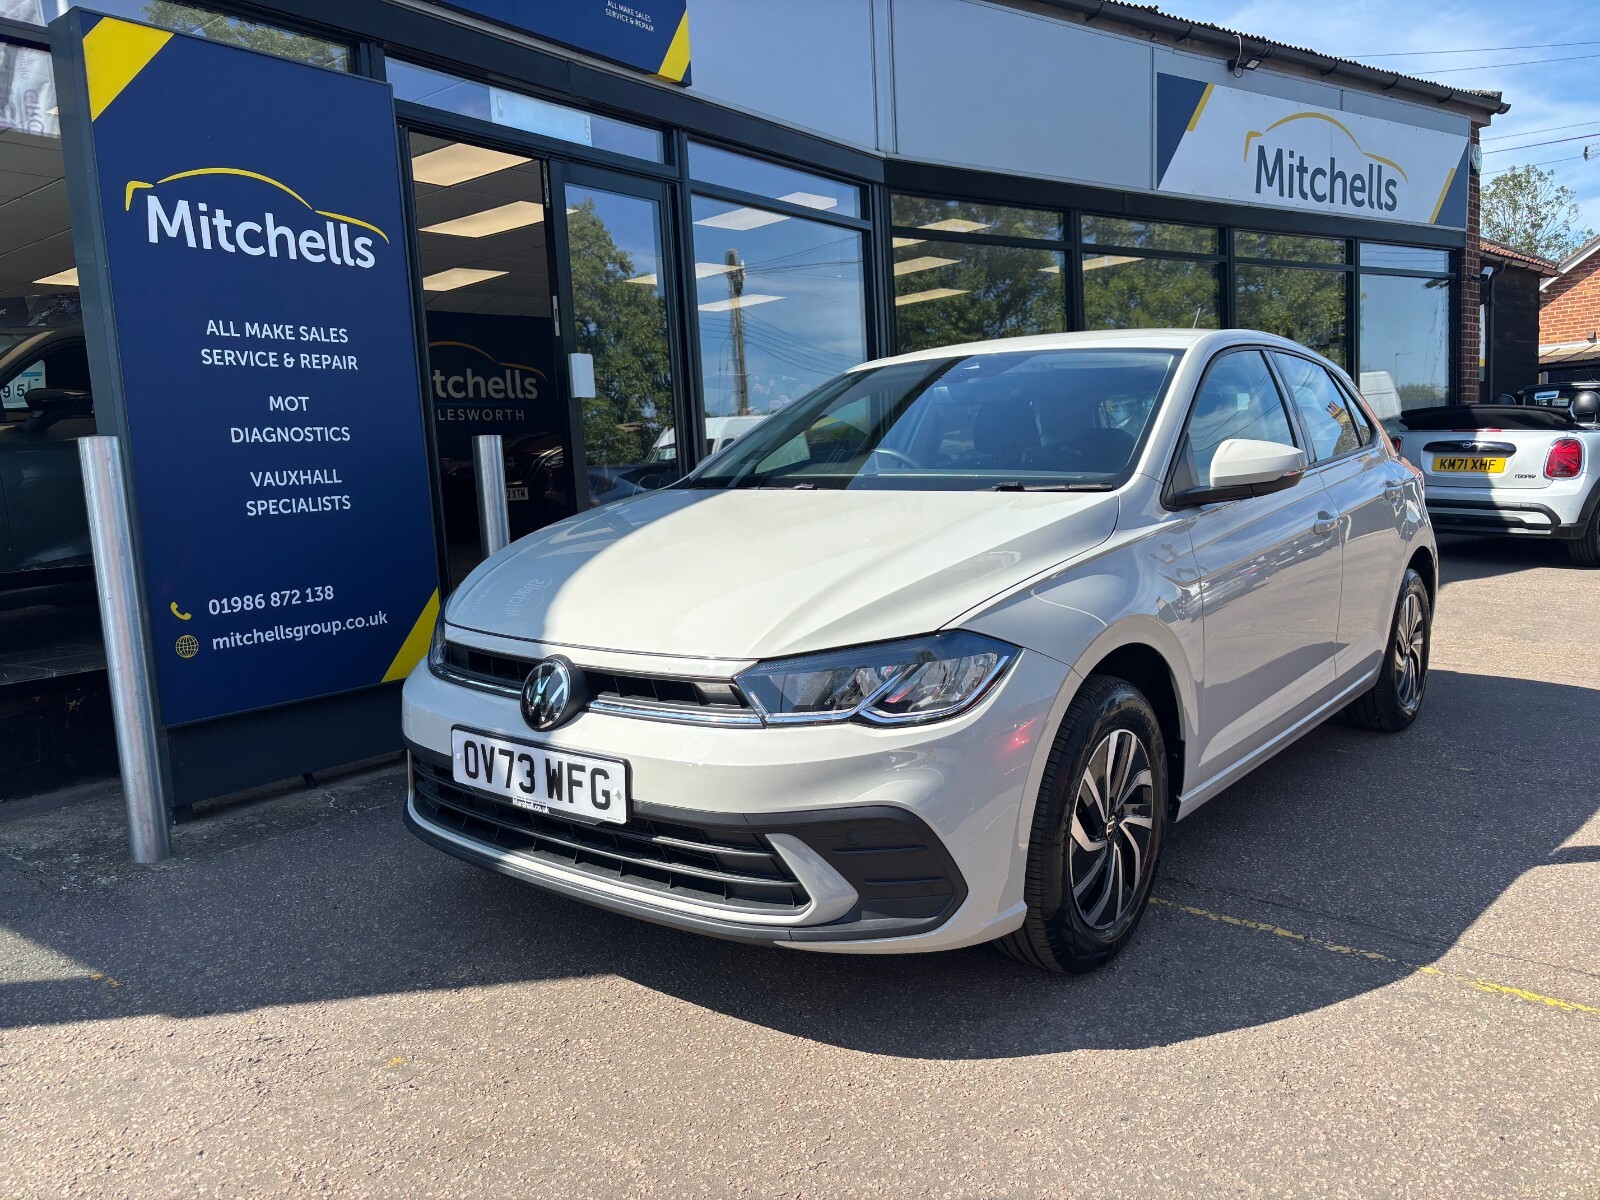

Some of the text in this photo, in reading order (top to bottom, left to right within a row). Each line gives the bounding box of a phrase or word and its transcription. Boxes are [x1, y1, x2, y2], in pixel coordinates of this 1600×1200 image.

[605, 8, 655, 32] SERVICE & REPAIR
[607, 0, 652, 23] ALL MAKE SALES
[1255, 145, 1397, 211] Mitchells
[147, 195, 376, 269] Mitchells
[206, 320, 349, 343] ALL MAKE SALES
[201, 349, 359, 371] SERVICE & REPAIR
[269, 396, 309, 411] MOT
[230, 427, 351, 443] DIAGNOSTICS
[1439, 459, 1497, 470] KM71 XHF
[250, 469, 342, 487] VAUXHALL
[246, 495, 351, 517] SPECIALISTS
[208, 585, 335, 615] 01986 872 138
[211, 610, 388, 650] mitchellsgroup.co.uk
[463, 740, 611, 811] OV73 WFG
